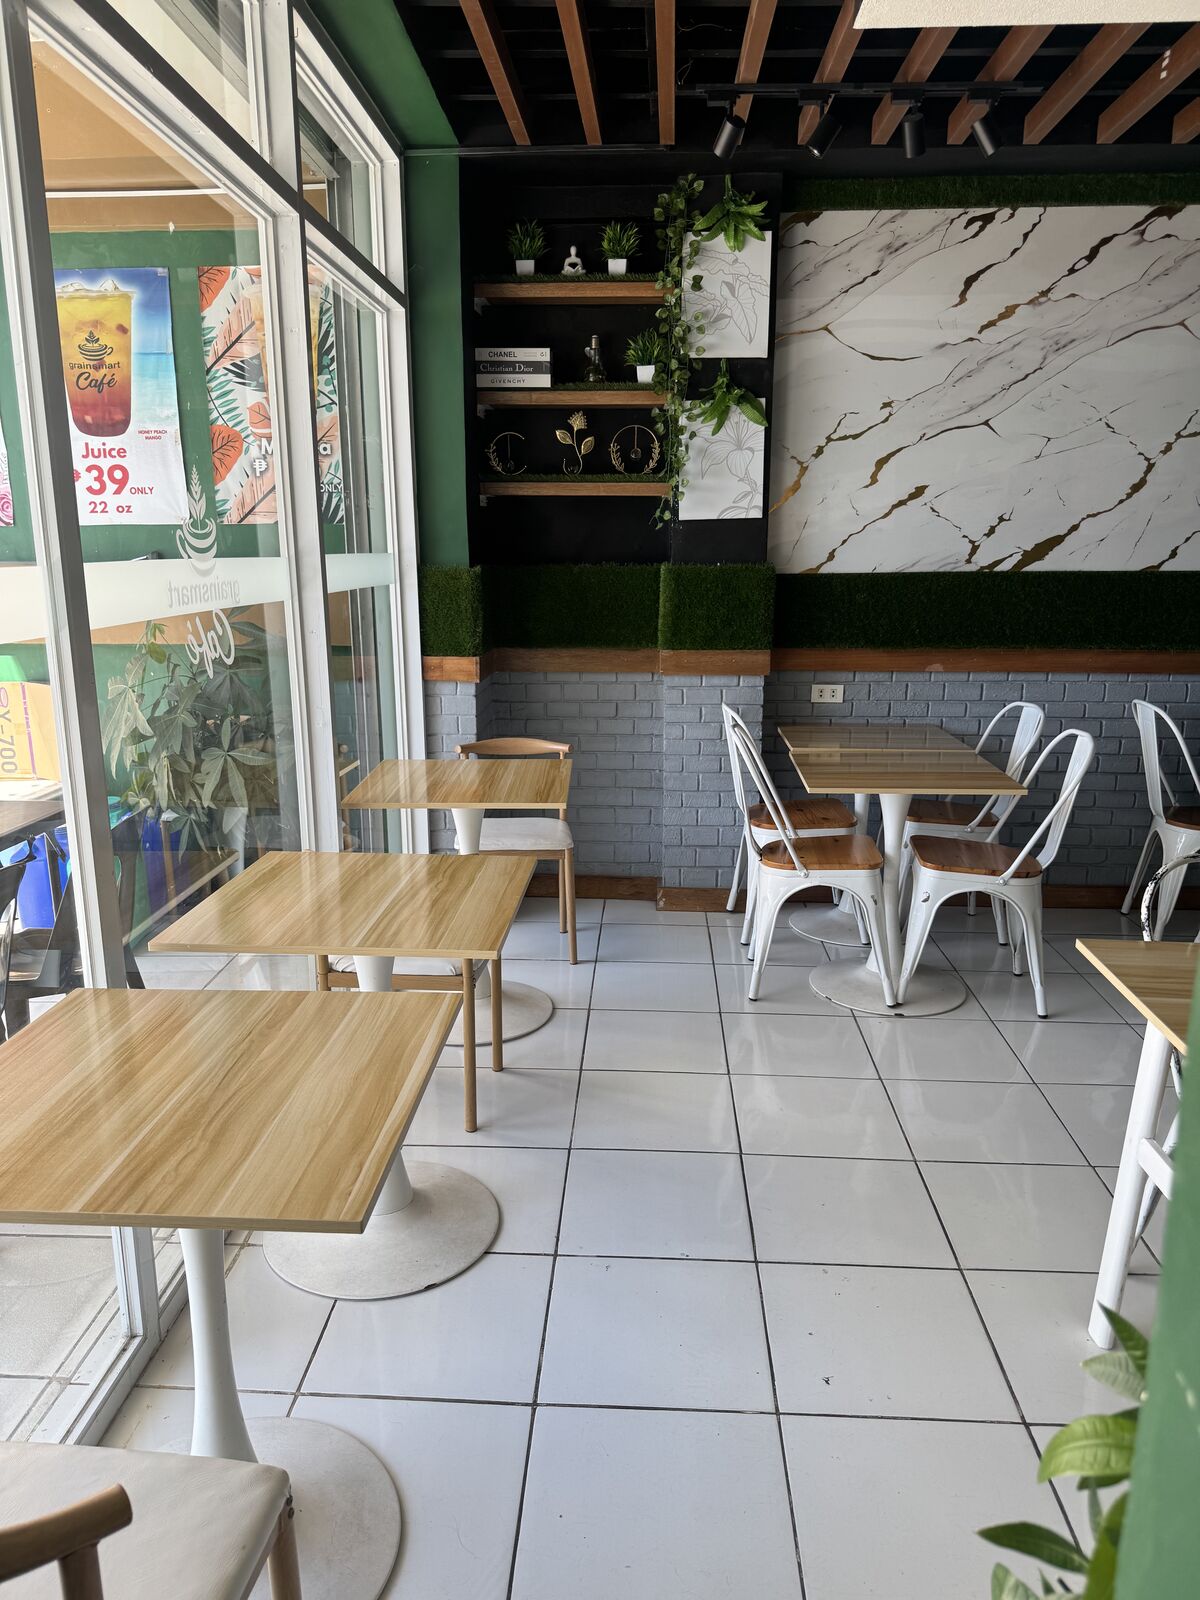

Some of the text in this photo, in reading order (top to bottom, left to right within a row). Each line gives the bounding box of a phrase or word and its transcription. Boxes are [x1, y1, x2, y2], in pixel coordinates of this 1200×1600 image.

[69, 361, 120, 370] grainsmart
[480, 363, 533, 372] Christian Dior
[75, 371, 117, 393] Café
[81, 442, 127, 459] Juice
[129, 487, 154, 495] ONLY
[89, 501, 133, 514] 22 oz
